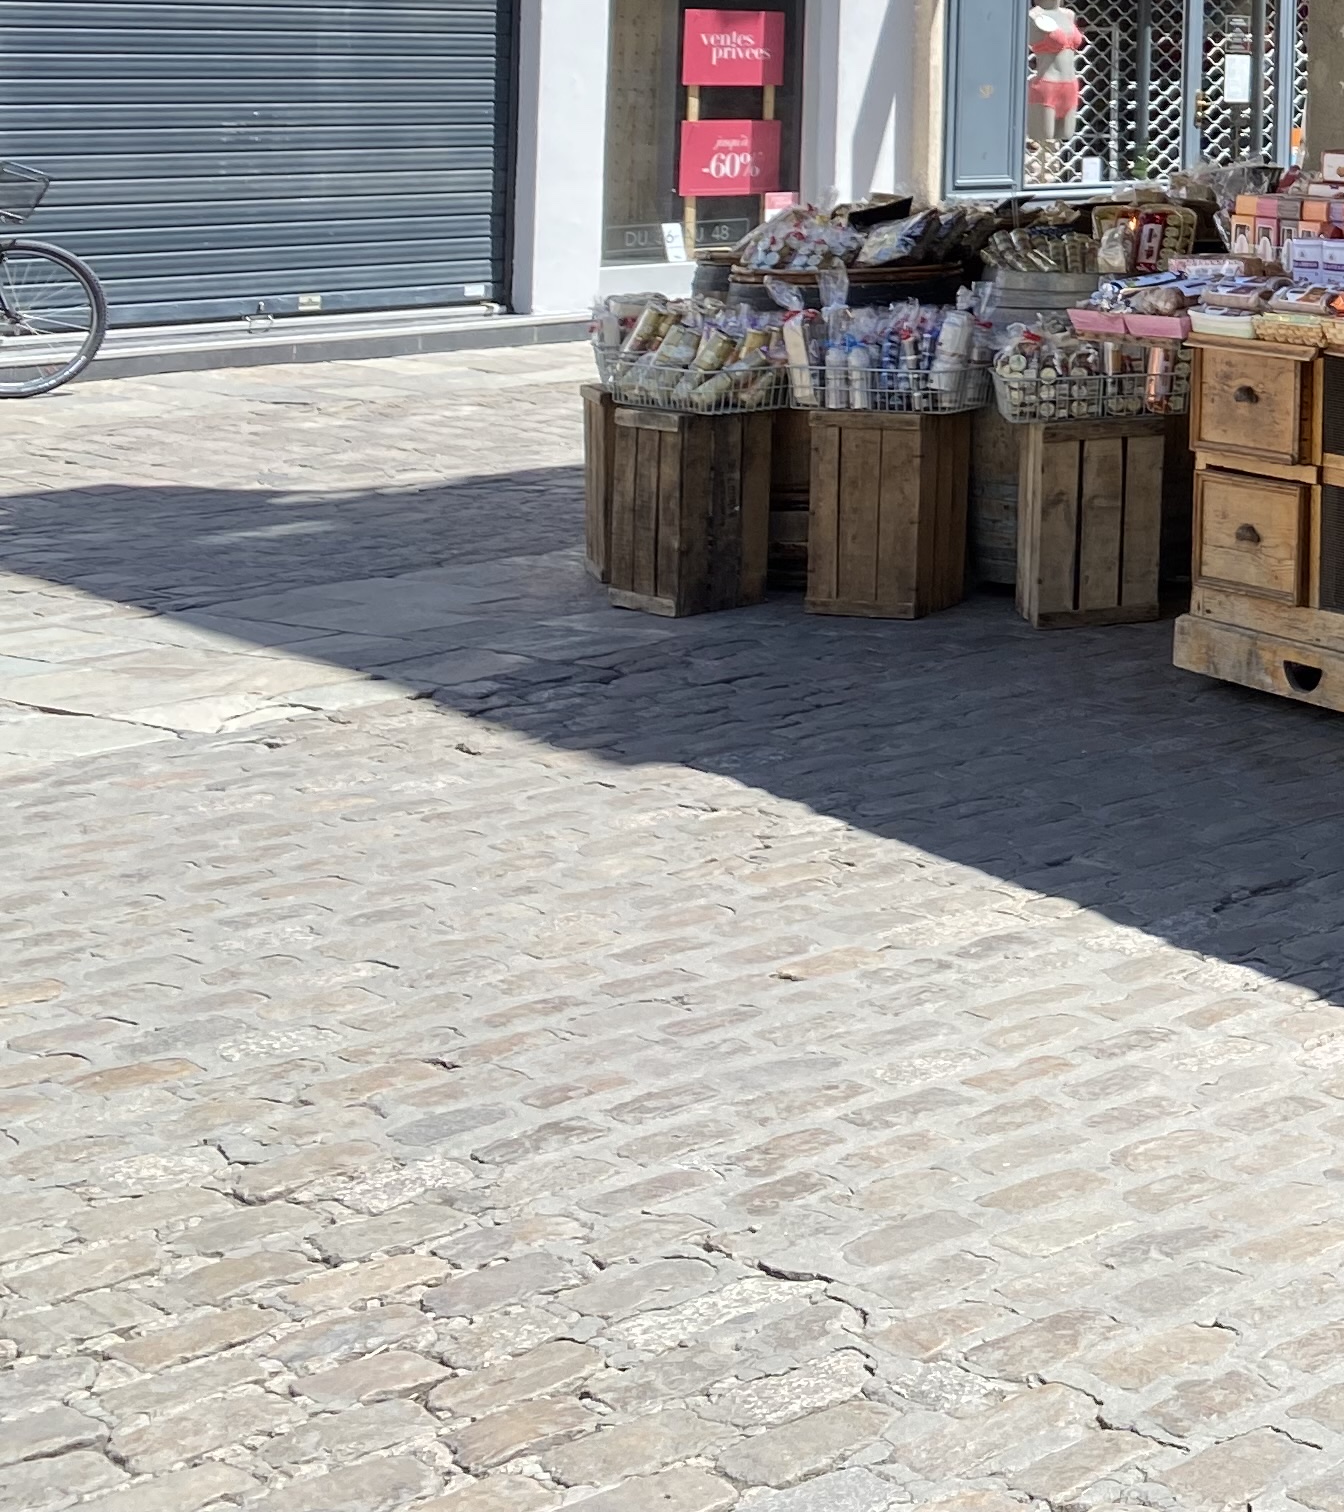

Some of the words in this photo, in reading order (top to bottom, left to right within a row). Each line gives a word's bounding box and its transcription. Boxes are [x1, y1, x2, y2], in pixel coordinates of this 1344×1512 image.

[700, 31, 755, 47] ventes
[701, 152, 760, 179] -60%
[624, 231, 648, 246] DU
[711, 224, 730, 241] 48
